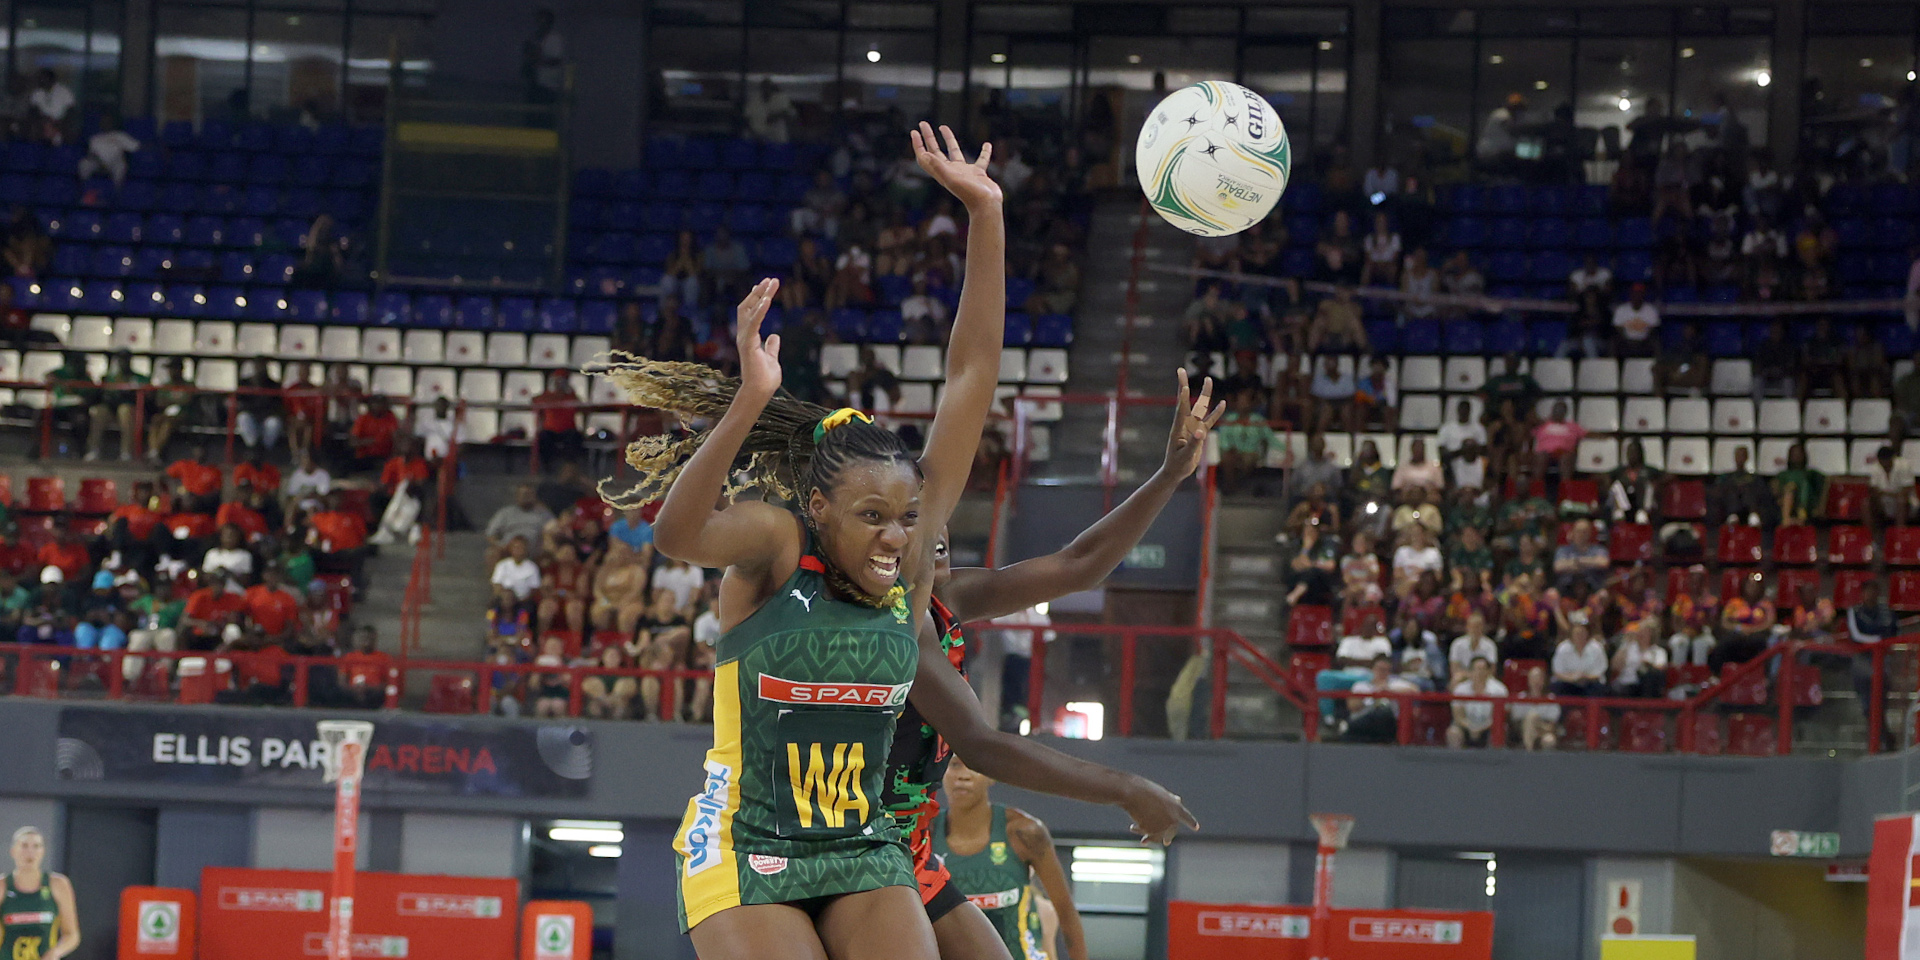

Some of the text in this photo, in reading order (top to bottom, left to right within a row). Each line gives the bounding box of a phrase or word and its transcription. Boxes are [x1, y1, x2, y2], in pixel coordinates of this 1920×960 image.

[1216, 178, 1263, 204] NETBALL
[790, 686, 889, 703] SPAR
[153, 732, 498, 776] ELLIS PAR ARENA
[786, 742, 869, 828] WA
[237, 891, 298, 906] SPAR
[415, 898, 475, 912] SPAR
[1219, 915, 1282, 934] SPAR
[1370, 921, 1434, 939] SPAR
[12, 936, 42, 960] GK
[322, 935, 382, 952] SAR
